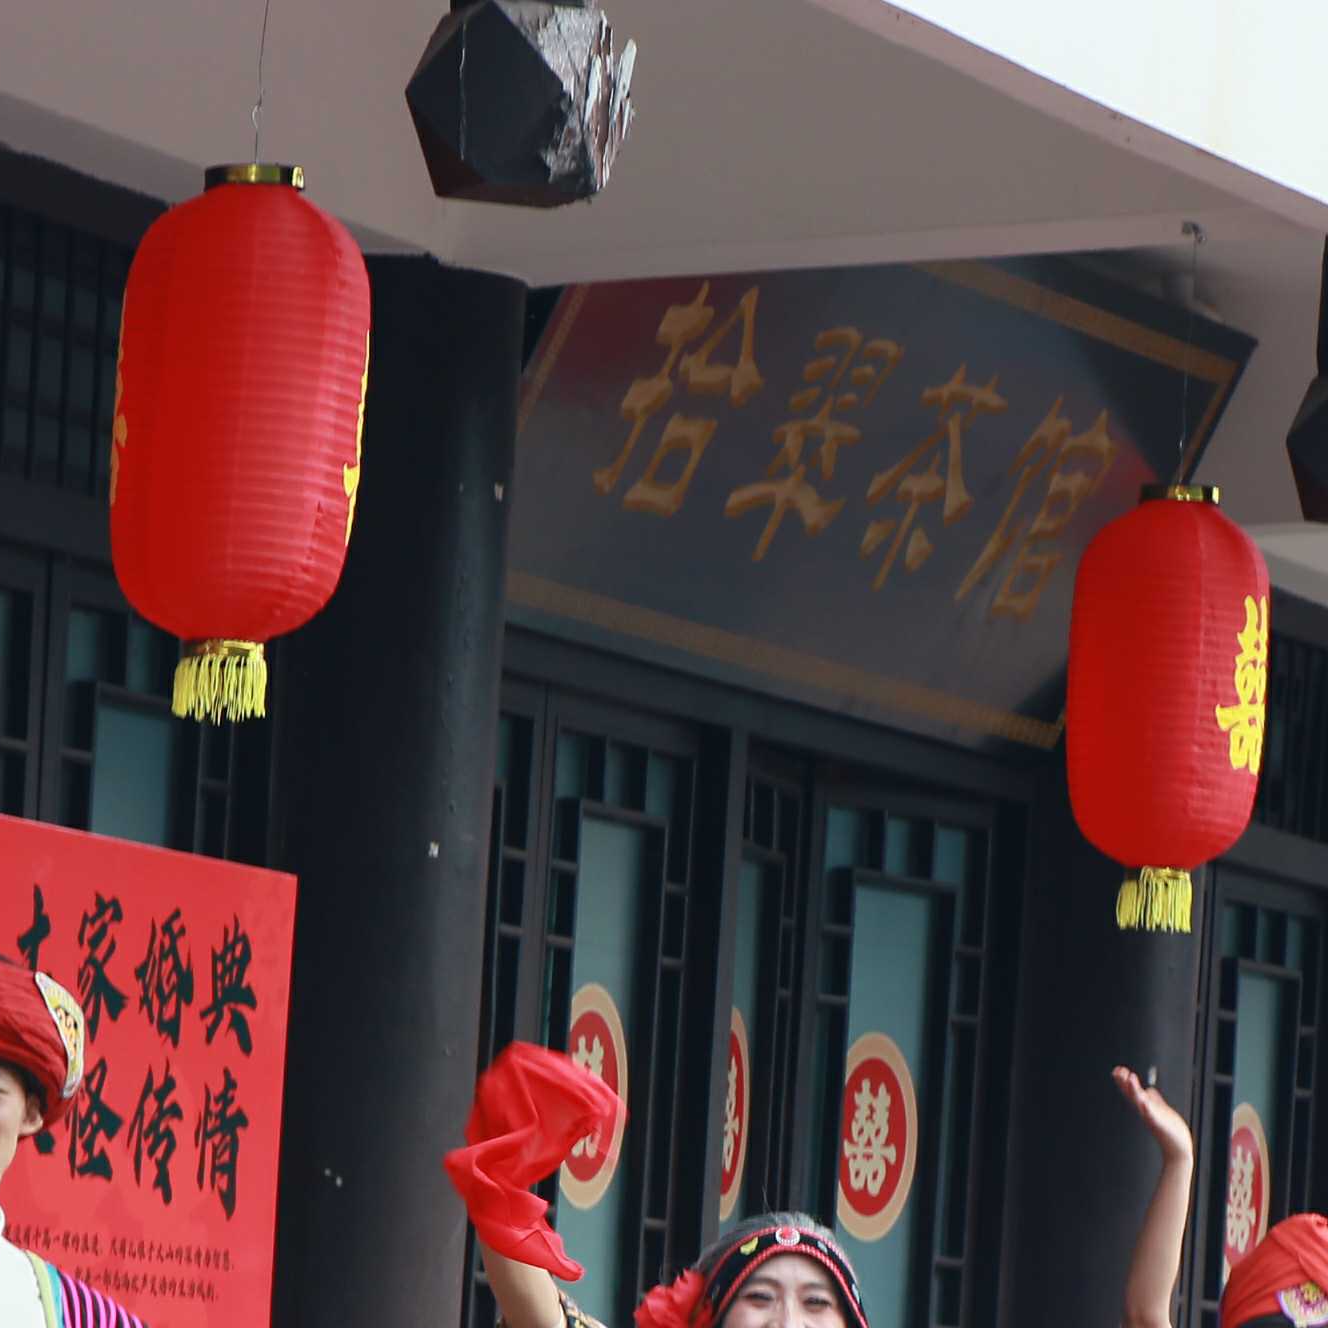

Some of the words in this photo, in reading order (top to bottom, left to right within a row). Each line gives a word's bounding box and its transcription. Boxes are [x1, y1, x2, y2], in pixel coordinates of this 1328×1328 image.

[34, 1056, 249, 1221] 怪传情
[843, 1078, 897, 1197] 囍
